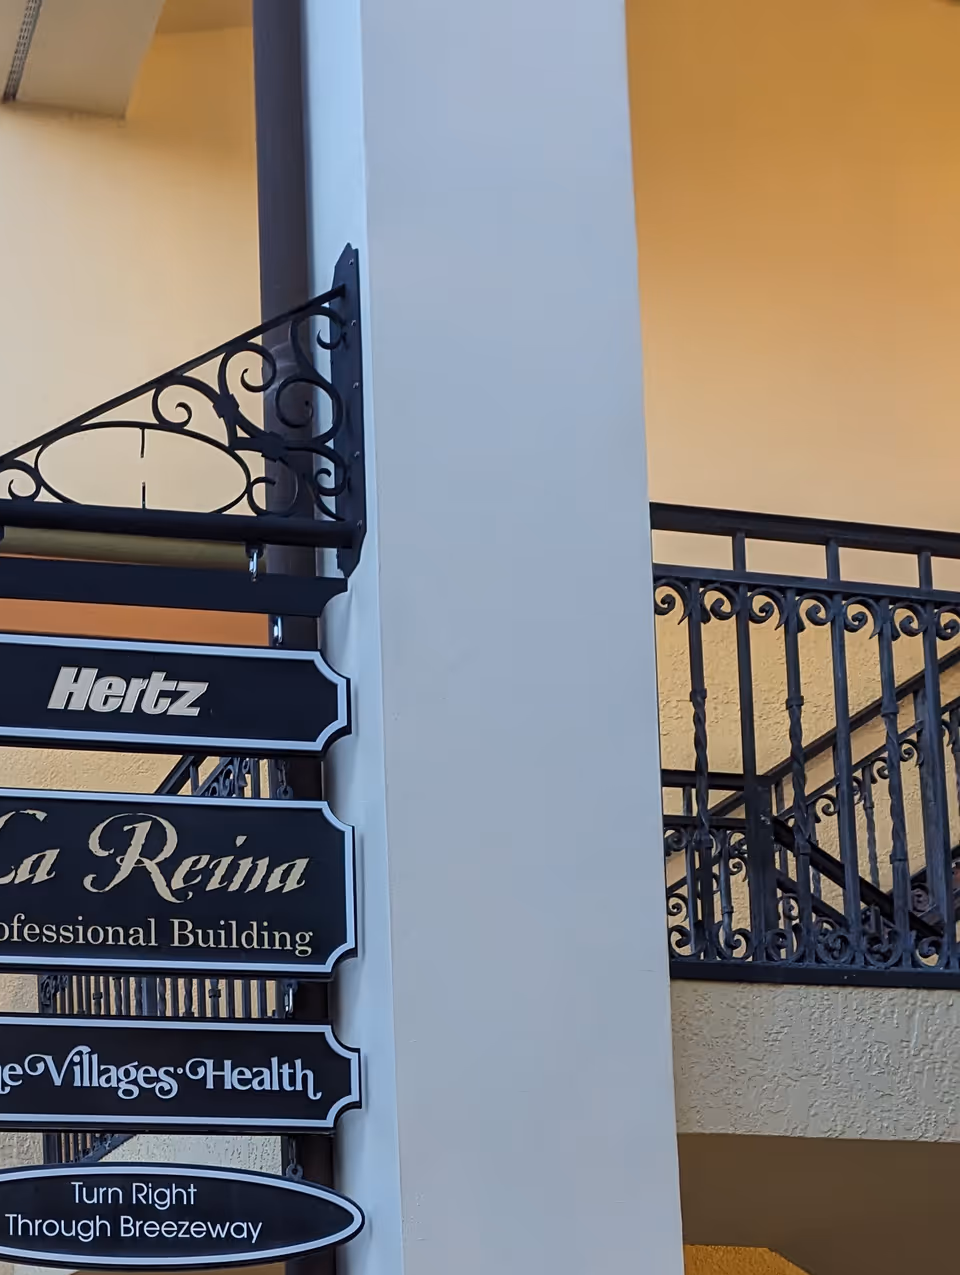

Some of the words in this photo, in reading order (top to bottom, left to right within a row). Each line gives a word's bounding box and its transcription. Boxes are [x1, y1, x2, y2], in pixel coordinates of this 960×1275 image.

[47, 666, 209, 717] Hertz
[83, 812, 311, 904] Reina
[170, 918, 313, 957] Building
[24, 1045, 179, 1100] Villages
[186, 1056, 322, 1101] Health
[71, 1181, 123, 1205] Turn
[132, 1183, 197, 1211] Right
[5, 1213, 111, 1243] Through
[120, 1216, 263, 1244] Breezeway
